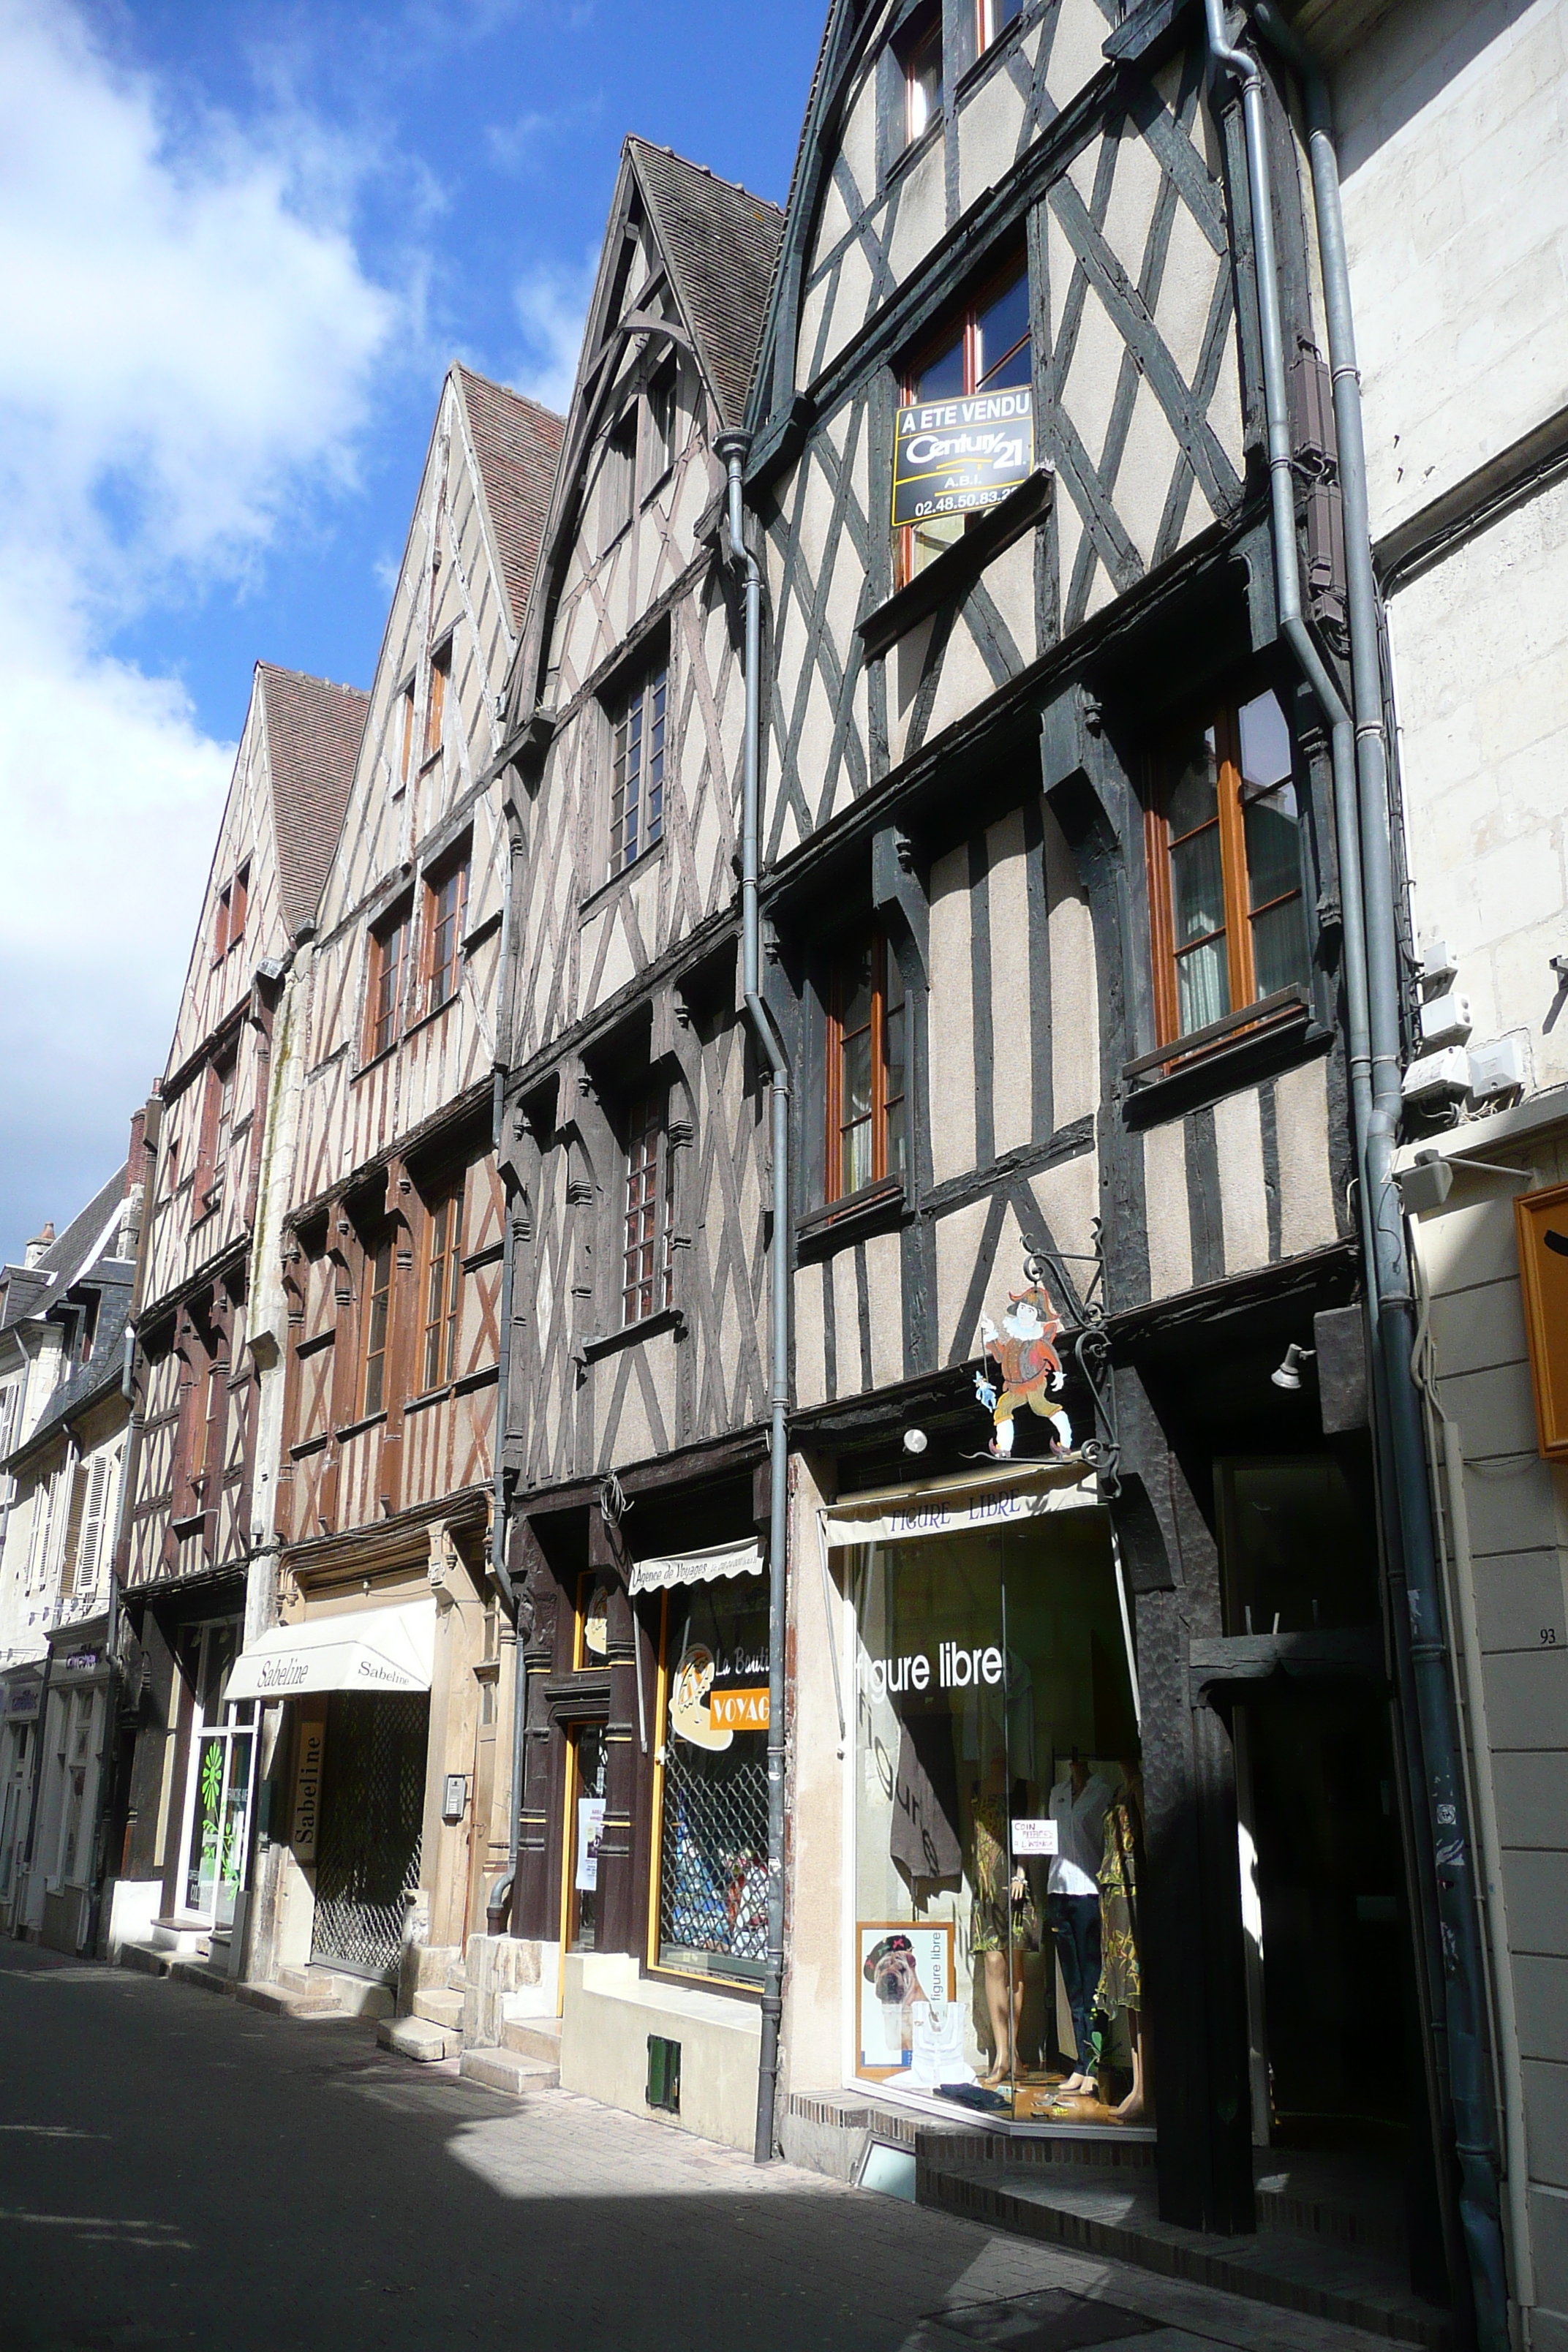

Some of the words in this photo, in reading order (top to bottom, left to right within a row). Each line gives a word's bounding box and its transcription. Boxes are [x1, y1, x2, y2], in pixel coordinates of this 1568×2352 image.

[902, 413, 915, 433] A
[920, 405, 957, 429] ETE
[962, 393, 1030, 422] VENDU
[906, 431, 1006, 464] Century
[992, 439, 1024, 470] 21
[944, 474, 982, 489] A.B.I.
[891, 1501, 951, 1532] FIGURE
[969, 1488, 1021, 1520] LIBRE
[663, 1564, 674, 1580] de
[676, 1563, 708, 1581] Voyages
[1540, 1628, 1556, 1644] 93
[257, 1658, 309, 1688] Sabeline
[358, 1661, 410, 1686] Sabeline
[715, 1648, 731, 1676] La
[856, 1652, 930, 1704] figure
[939, 1641, 1003, 1687] libre
[295, 1736, 321, 1844] Sabeline
[1014, 1823, 1036, 1831] COIN
[930, 1932, 941, 1960] libre
[930, 1964, 943, 2001] figure
